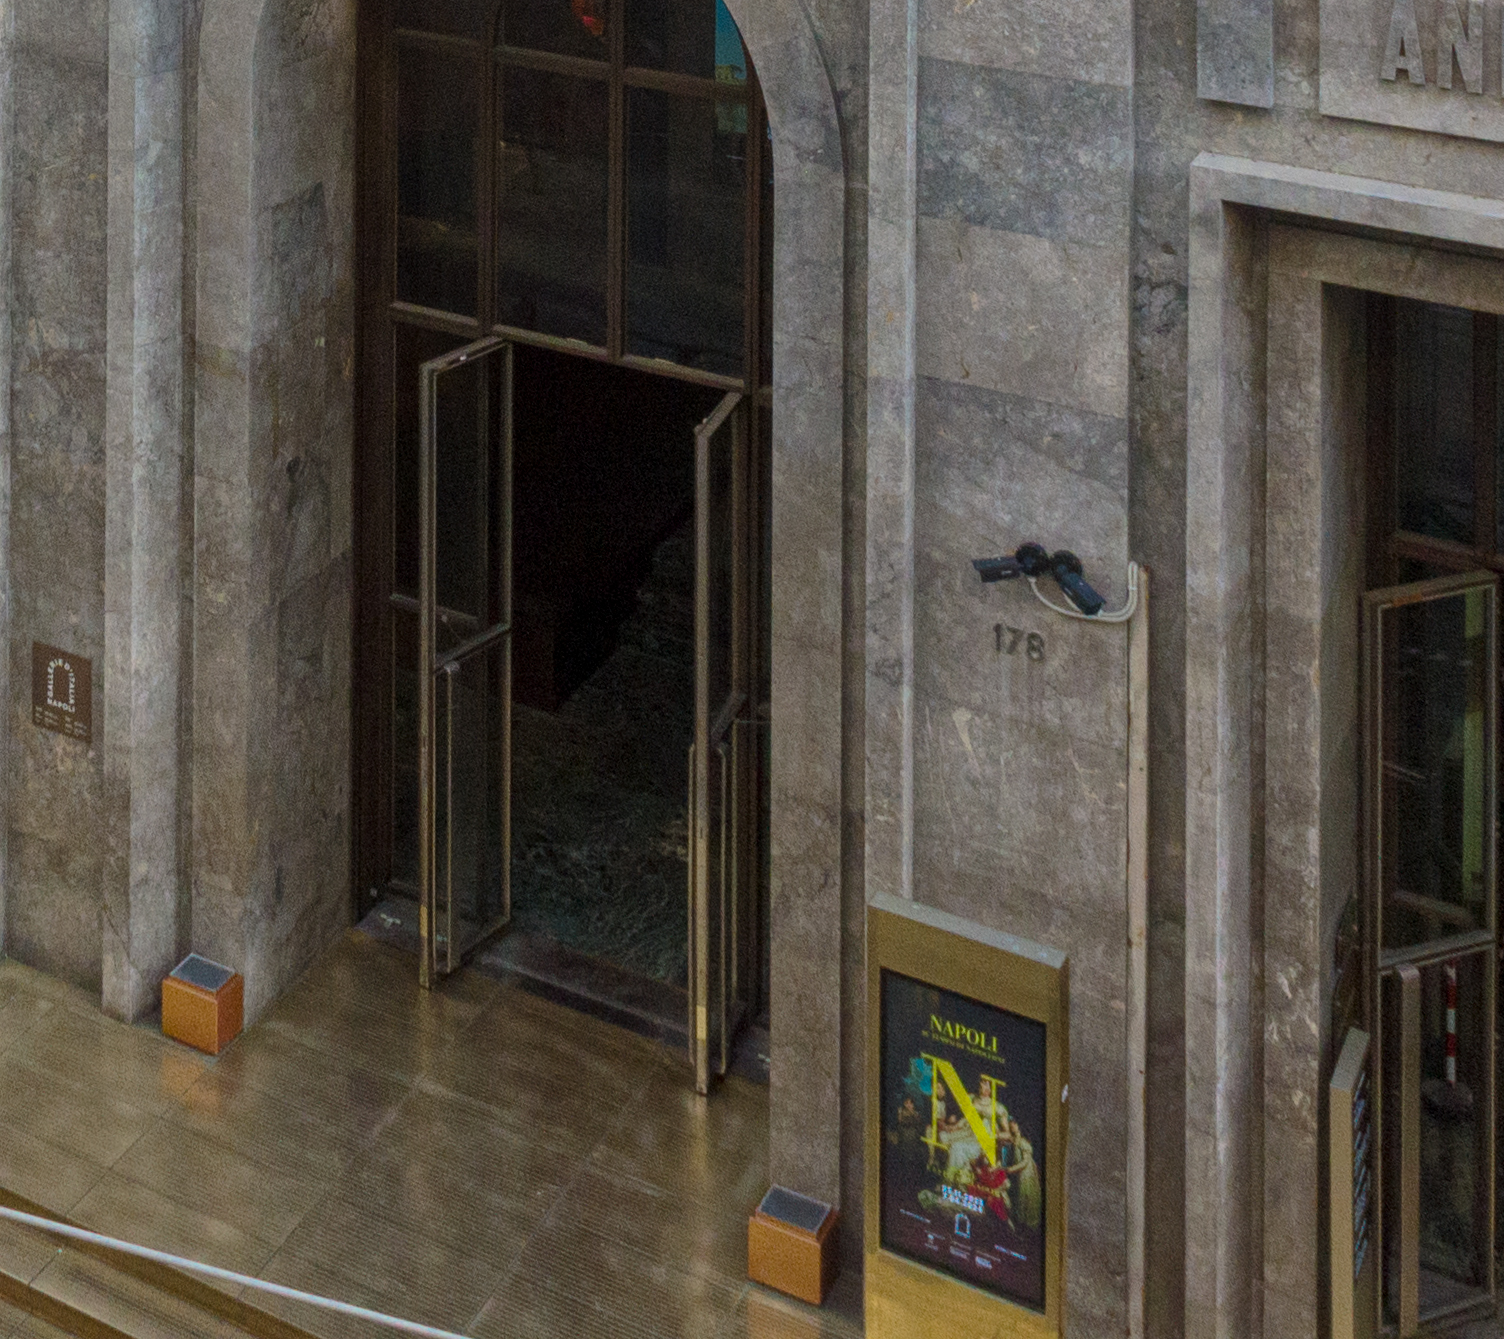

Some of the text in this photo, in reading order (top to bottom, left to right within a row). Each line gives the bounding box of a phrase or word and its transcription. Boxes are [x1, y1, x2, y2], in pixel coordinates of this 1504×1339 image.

[993, 623, 1045, 661] 178
[930, 1014, 998, 1053] NAPOLI
[920, 1051, 1006, 1167] N
